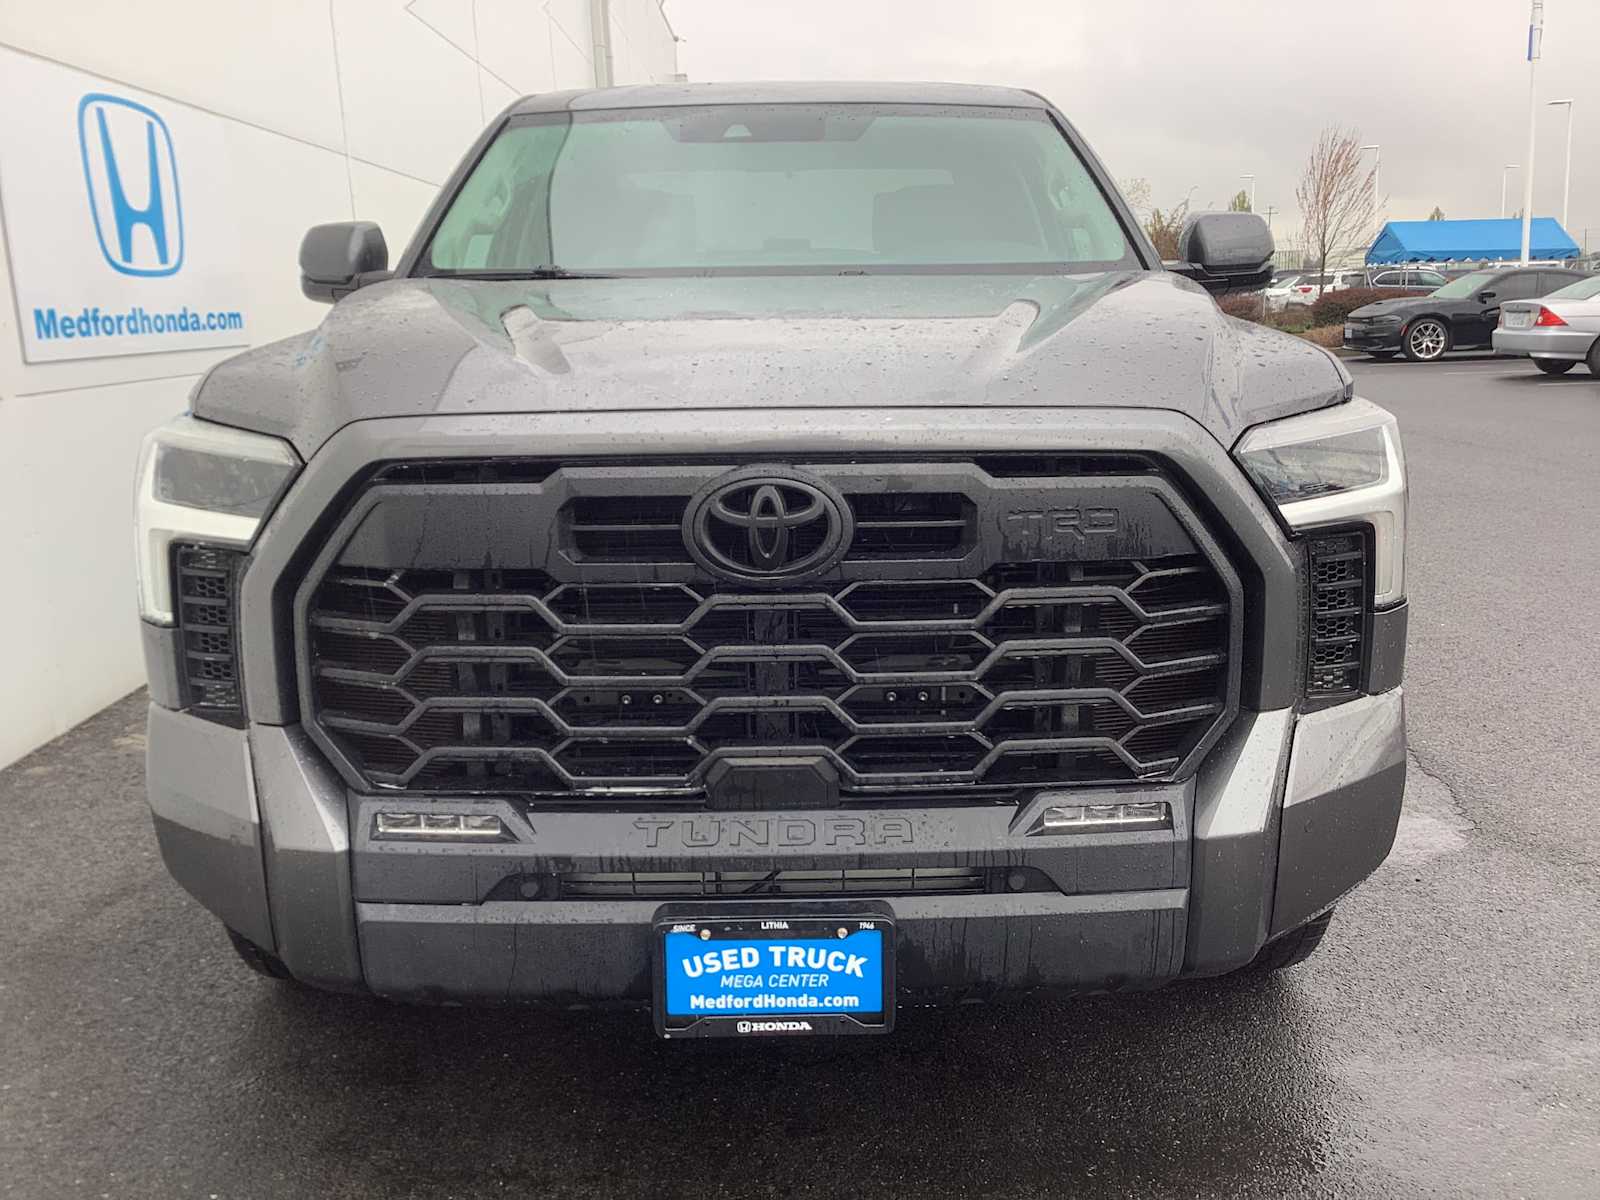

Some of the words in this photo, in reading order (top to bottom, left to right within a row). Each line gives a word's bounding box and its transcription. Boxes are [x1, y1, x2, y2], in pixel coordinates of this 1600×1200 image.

[33, 308, 243, 340] Medfordhonda.com
[1007, 506, 1121, 540] TRD
[632, 818, 914, 848] TUNDRA
[760, 921, 789, 930] LITHIA
[682, 946, 760, 979] USED
[768, 945, 869, 978] TRUCK
[720, 974, 764, 988] MEGA
[768, 974, 829, 988] CENTER
[690, 994, 860, 1010] MedfordHonda.com
[751, 1021, 813, 1032] HONDA
